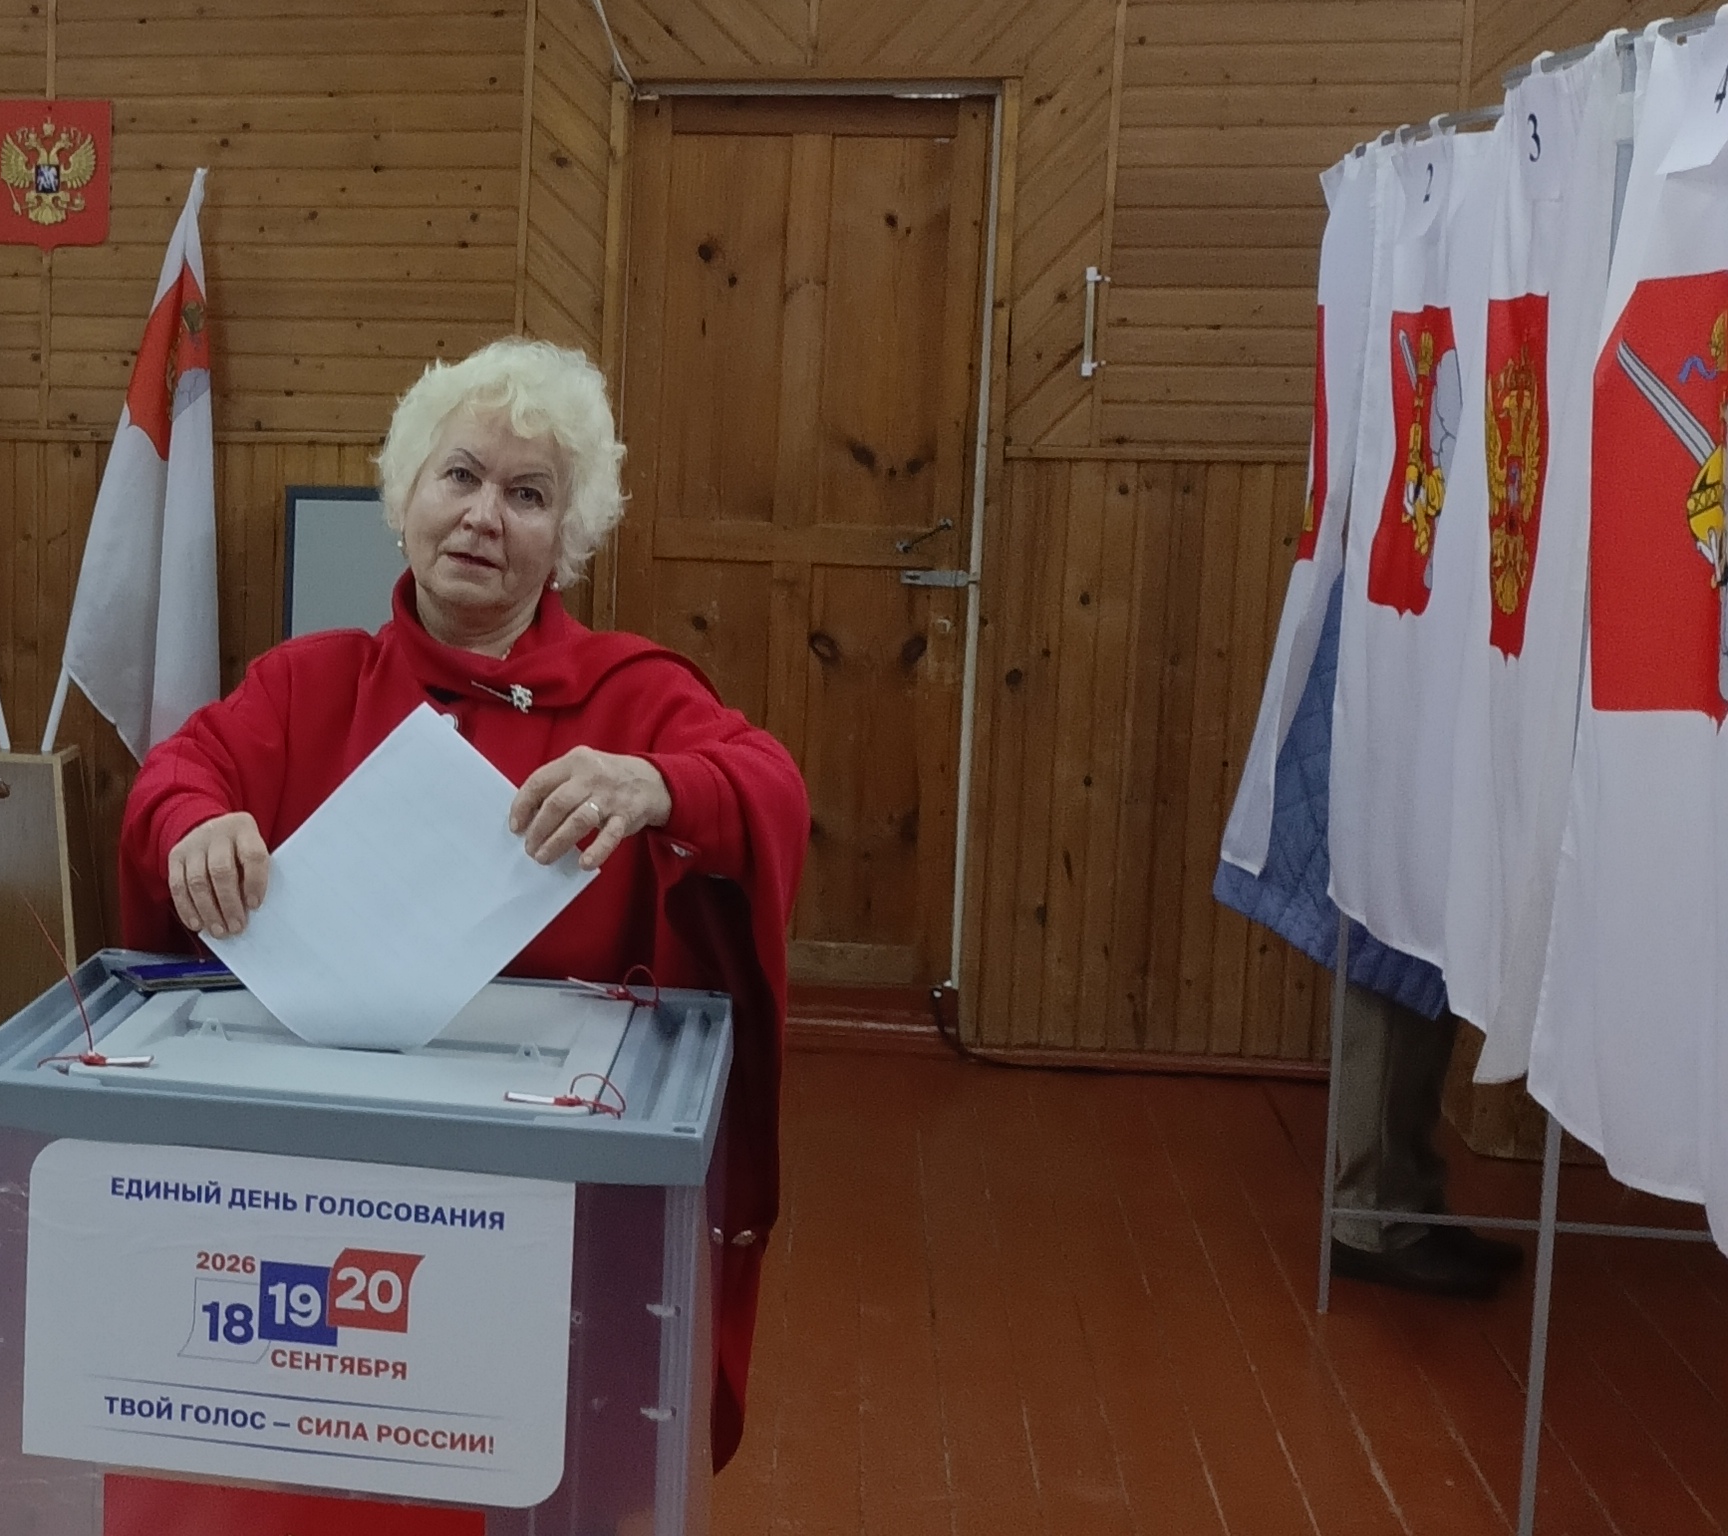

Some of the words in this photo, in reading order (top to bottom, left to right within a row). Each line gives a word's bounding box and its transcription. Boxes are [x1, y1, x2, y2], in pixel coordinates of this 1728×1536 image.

[1714, 64, 1728, 114] 4
[1527, 113, 1541, 163] 3
[1423, 162, 1434, 204] 2
[110, 1176, 222, 1205] ЕДИНЫЙ
[228, 1187, 298, 1211] ДЕНЬ
[305, 1193, 505, 1231] ГОЛОСОВАНИЯ
[196, 1251, 256, 1274] 2026
[202, 1301, 254, 1344] 18
[268, 1282, 322, 1327] 19
[335, 1267, 402, 1314] 20
[271, 1349, 407, 1380] СЕНТЯБРЯ
[104, 1396, 173, 1420] ТВОЙ
[181, 1404, 266, 1430] ГОЛОС
[297, 1416, 369, 1441] СИЛА
[376, 1424, 494, 1455] РОССИИ!
